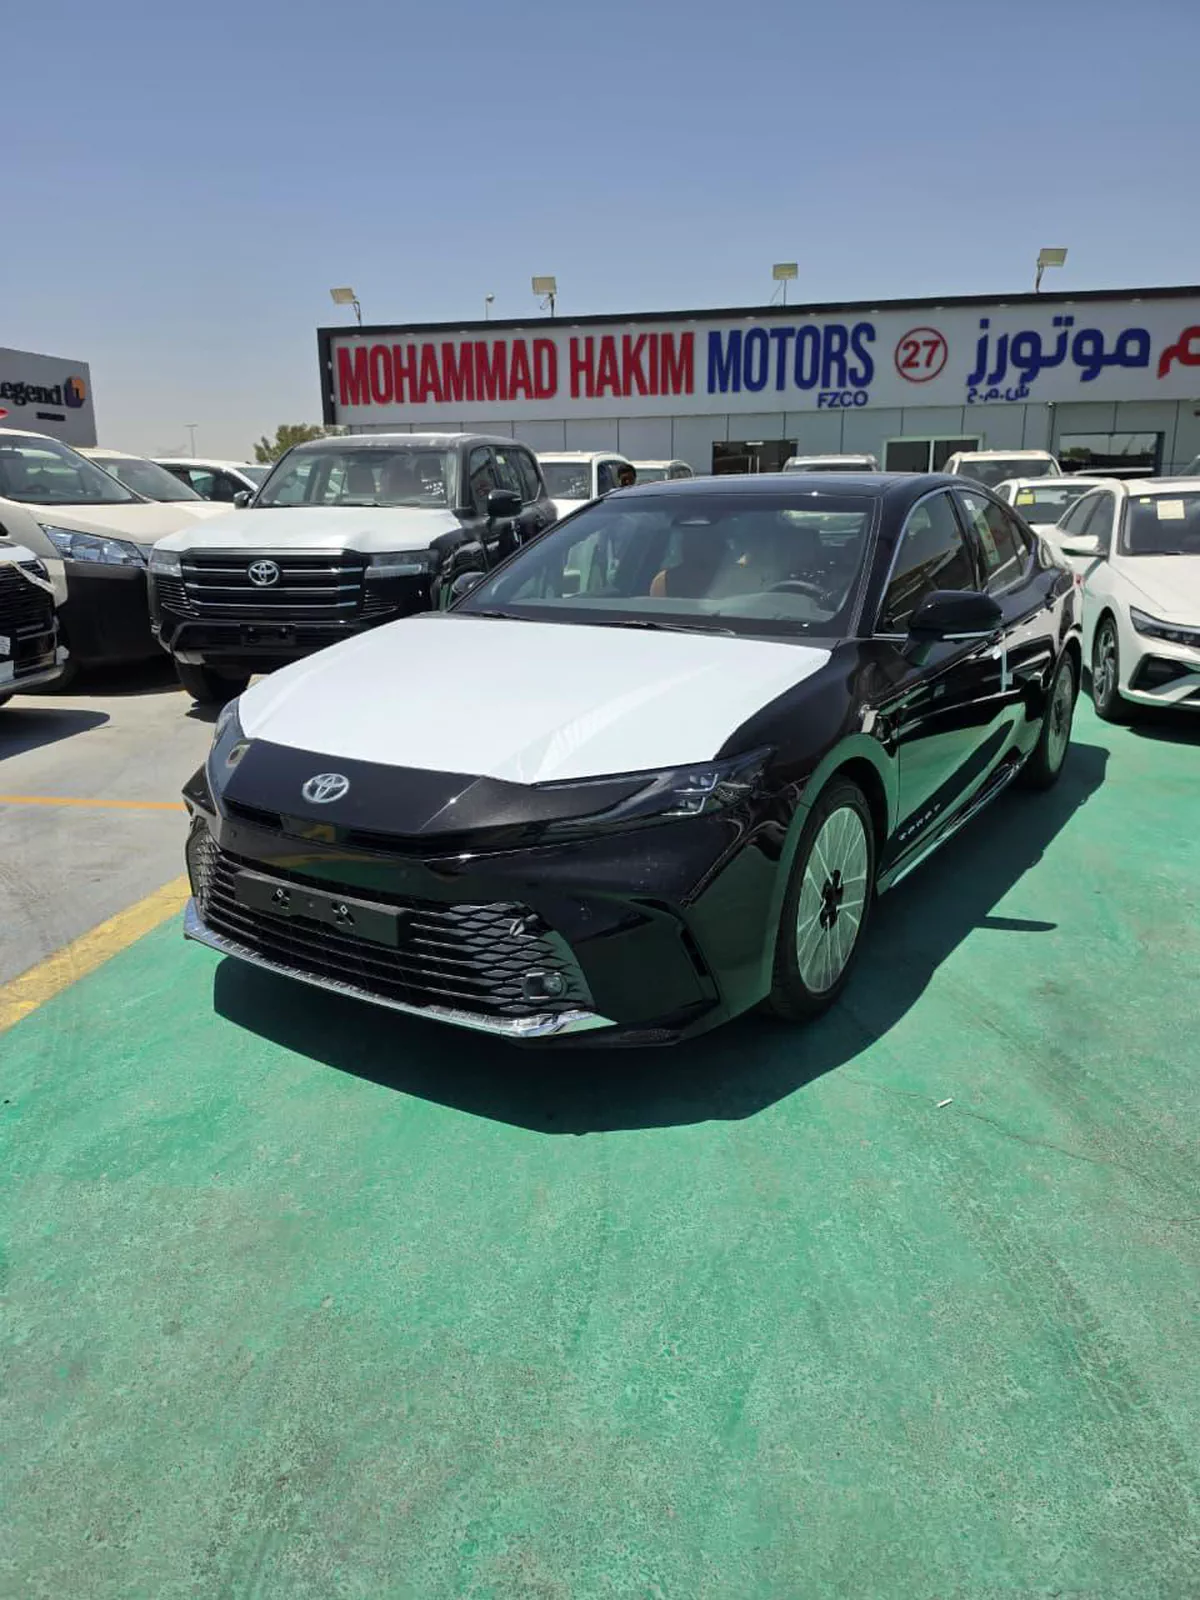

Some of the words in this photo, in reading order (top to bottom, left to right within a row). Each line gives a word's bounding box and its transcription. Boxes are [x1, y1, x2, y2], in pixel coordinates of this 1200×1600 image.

[337, 338, 558, 406] MOHAMMAD
[569, 332, 695, 399] HAKIM
[707, 322, 876, 394] MOTORS
[901, 339, 941, 369] 27
[966, 316, 1151, 386] موتورز
[0, 381, 63, 406] egend
[817, 390, 869, 408] FZCO
